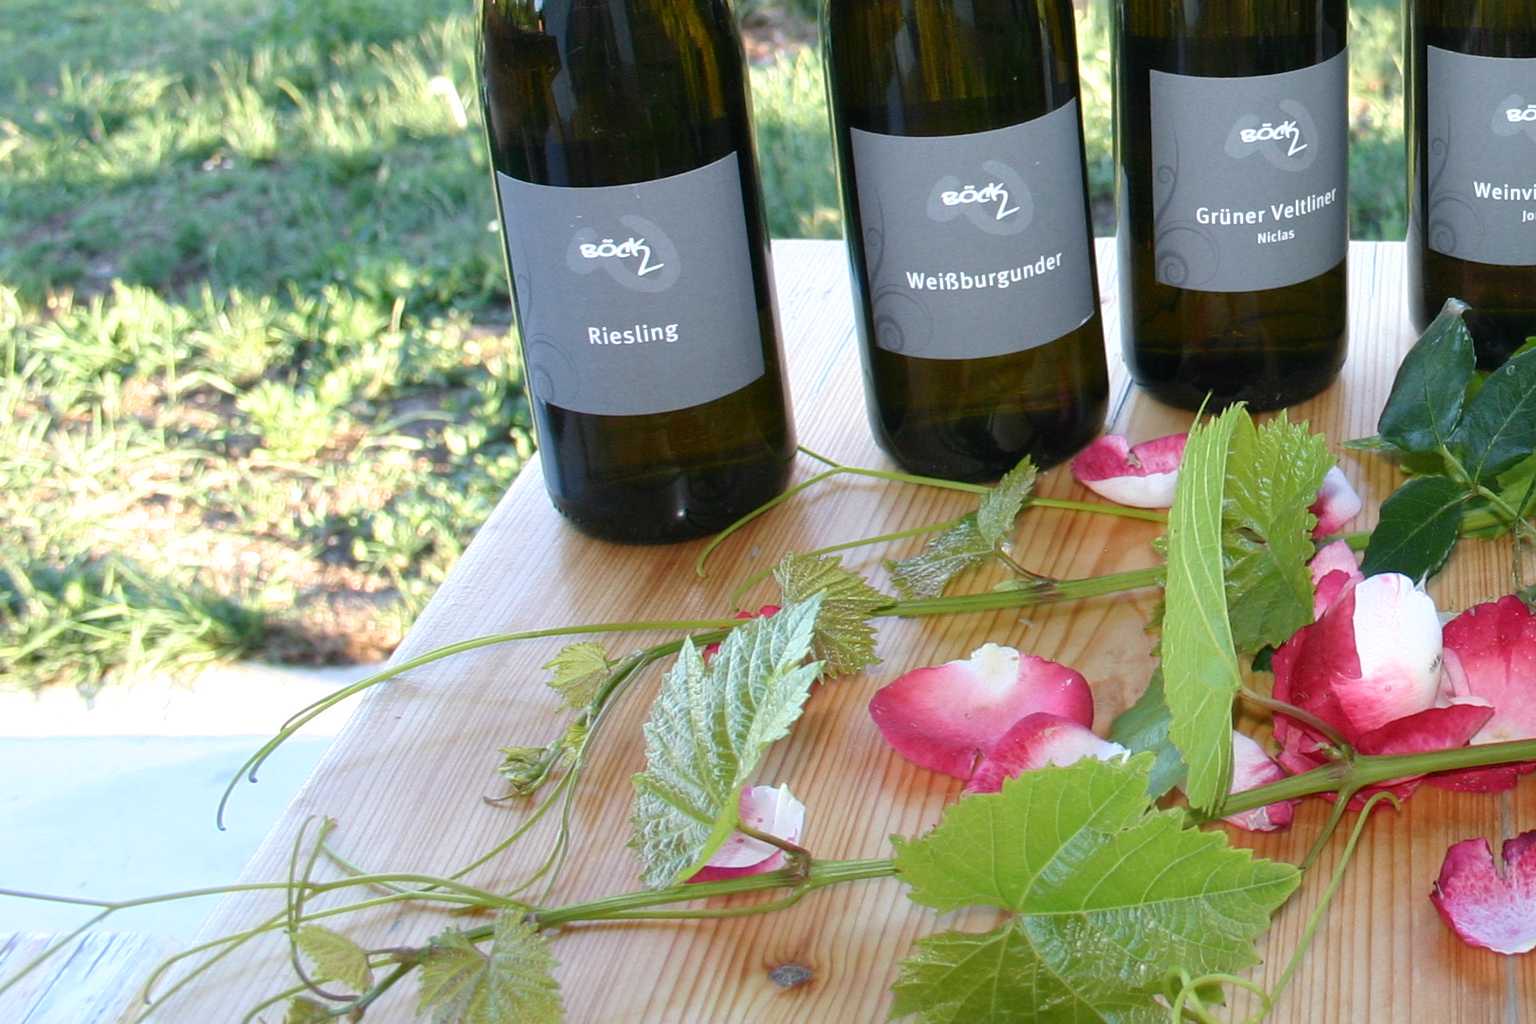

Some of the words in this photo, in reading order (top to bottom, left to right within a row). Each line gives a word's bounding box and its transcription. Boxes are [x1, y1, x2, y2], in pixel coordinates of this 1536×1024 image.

[1196, 207, 1266, 226] Grüner
[1270, 187, 1337, 221] Veltliner
[1257, 229, 1295, 244] Niclas
[906, 251, 1063, 290] Weißburgunder
[587, 323, 679, 345] Riesling
